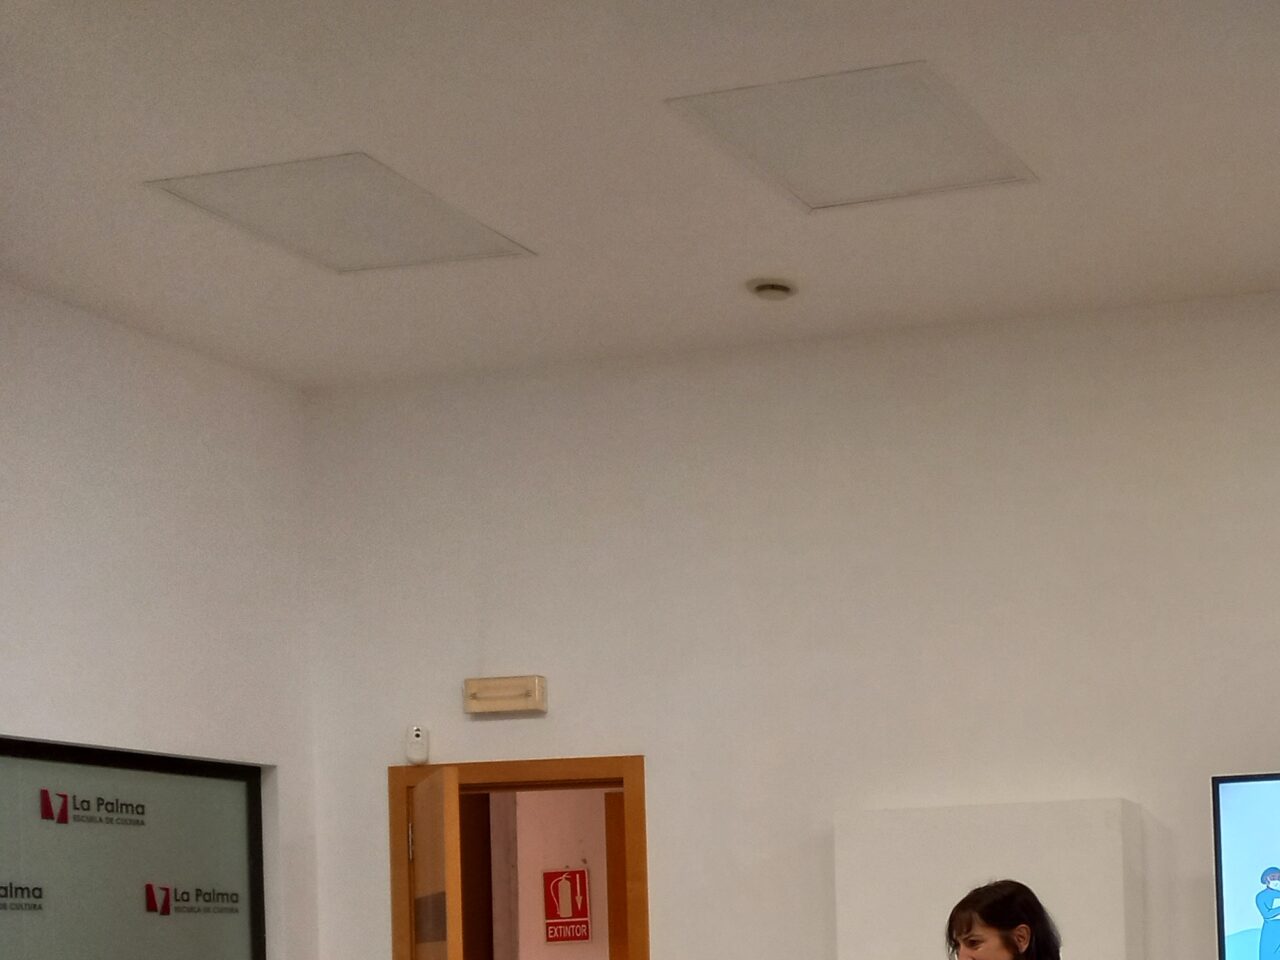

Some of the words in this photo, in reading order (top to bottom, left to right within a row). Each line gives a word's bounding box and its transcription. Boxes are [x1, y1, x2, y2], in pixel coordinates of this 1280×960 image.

[72, 795, 91, 811] La
[96, 797, 145, 815] Palma
[0, 882, 43, 899] alma
[174, 888, 190, 902] La
[195, 888, 239, 903] Palma
[548, 925, 588, 938] EXTINTOR
